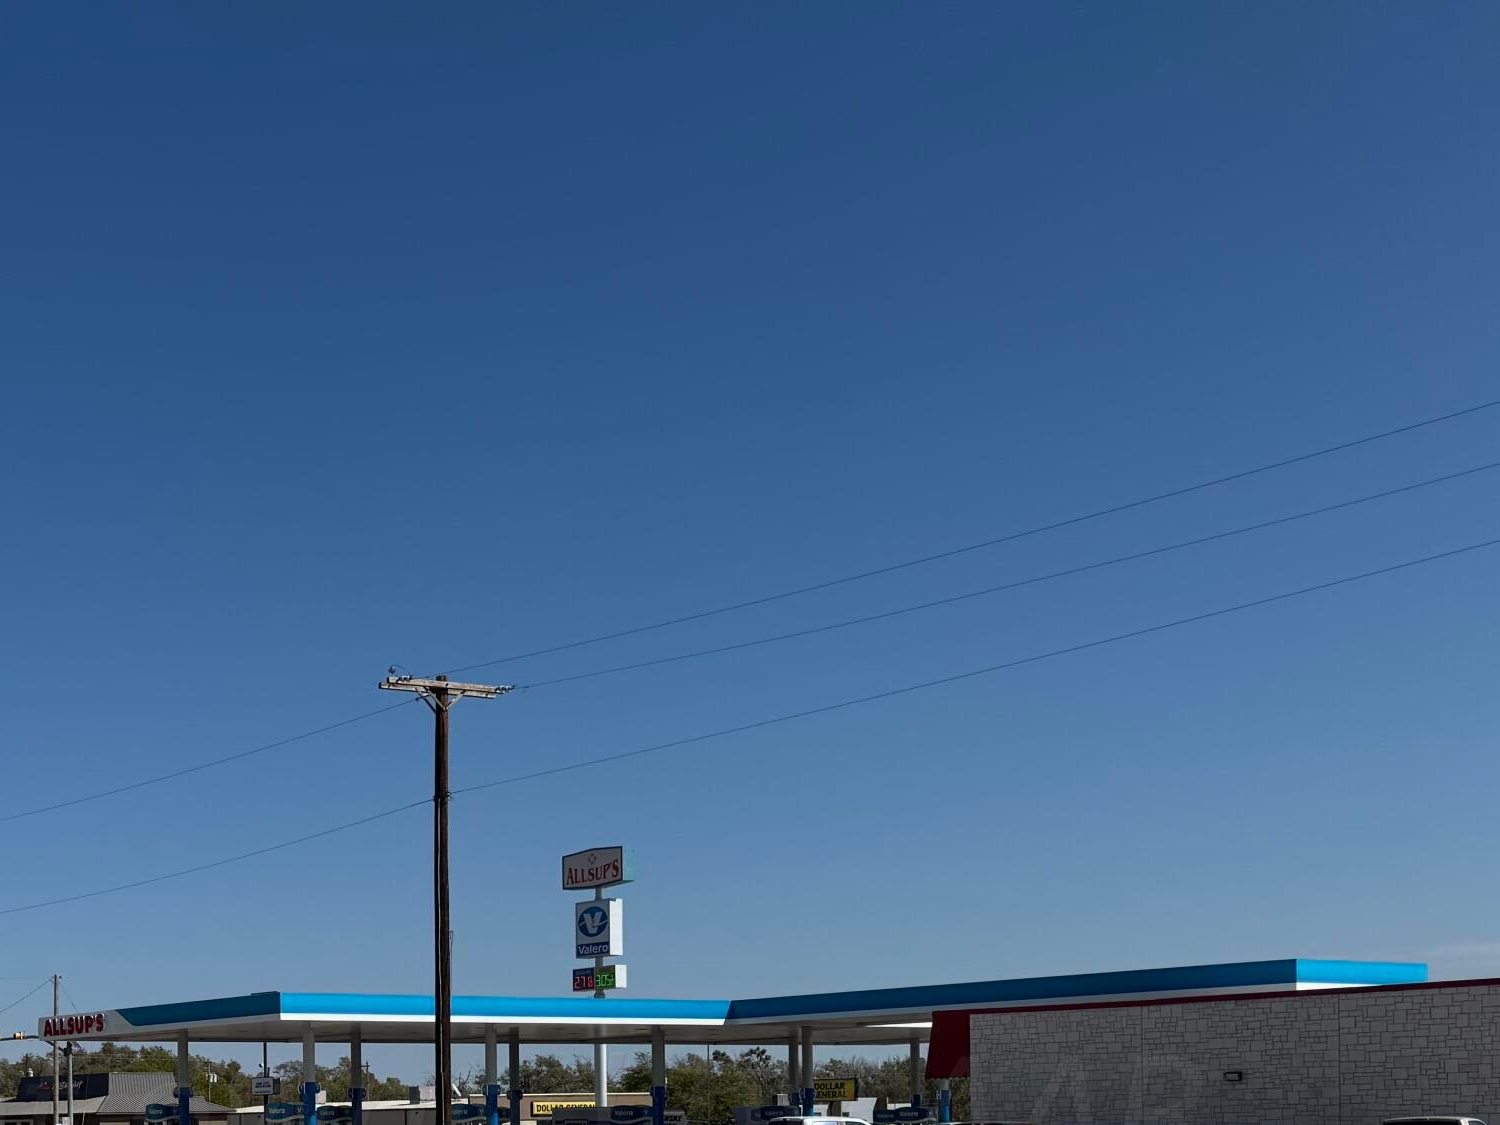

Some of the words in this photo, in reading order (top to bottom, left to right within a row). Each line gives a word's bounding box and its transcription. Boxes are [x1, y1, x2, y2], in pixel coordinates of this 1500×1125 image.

[566, 858, 619, 885] ALLSUP'S
[578, 944, 609, 955] Valero
[43, 1013, 105, 1037] ALLSUP'S
[814, 1082, 846, 1090] DOLLAR
